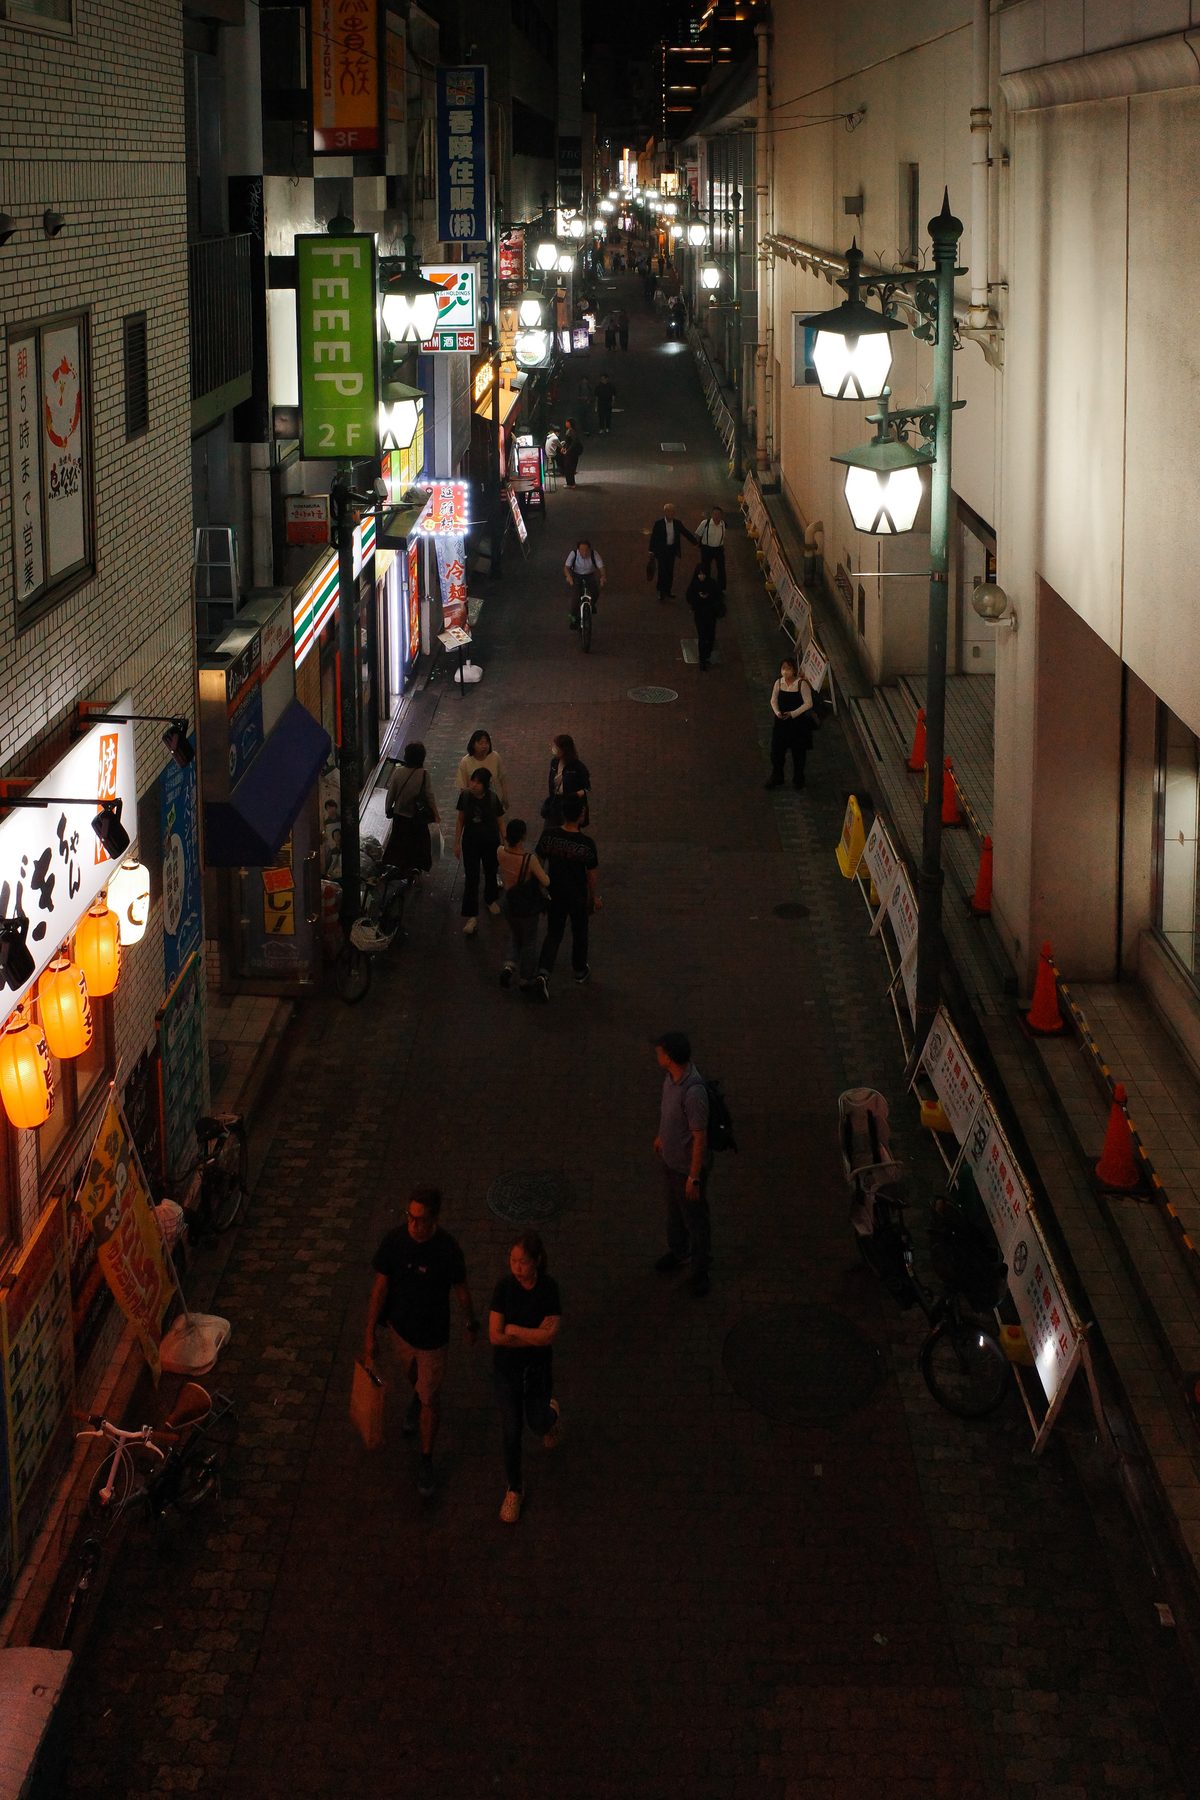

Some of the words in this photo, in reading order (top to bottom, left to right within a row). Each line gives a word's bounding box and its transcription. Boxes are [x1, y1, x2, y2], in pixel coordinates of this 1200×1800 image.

[335, 131, 359, 147] 3F
[311, 246, 364, 396] FEEEP
[443, 336, 454, 348] 酒
[458, 335, 475, 347] たばこ
[16, 347, 35, 592] 朝5時まで営業
[95, 736, 118, 861] 焼
[947, 1046, 976, 1110] 駐輪禁止
[991, 1143, 1021, 1219] 駐輪禁止
[1034, 1263, 1069, 1357] 駐輪禁止
